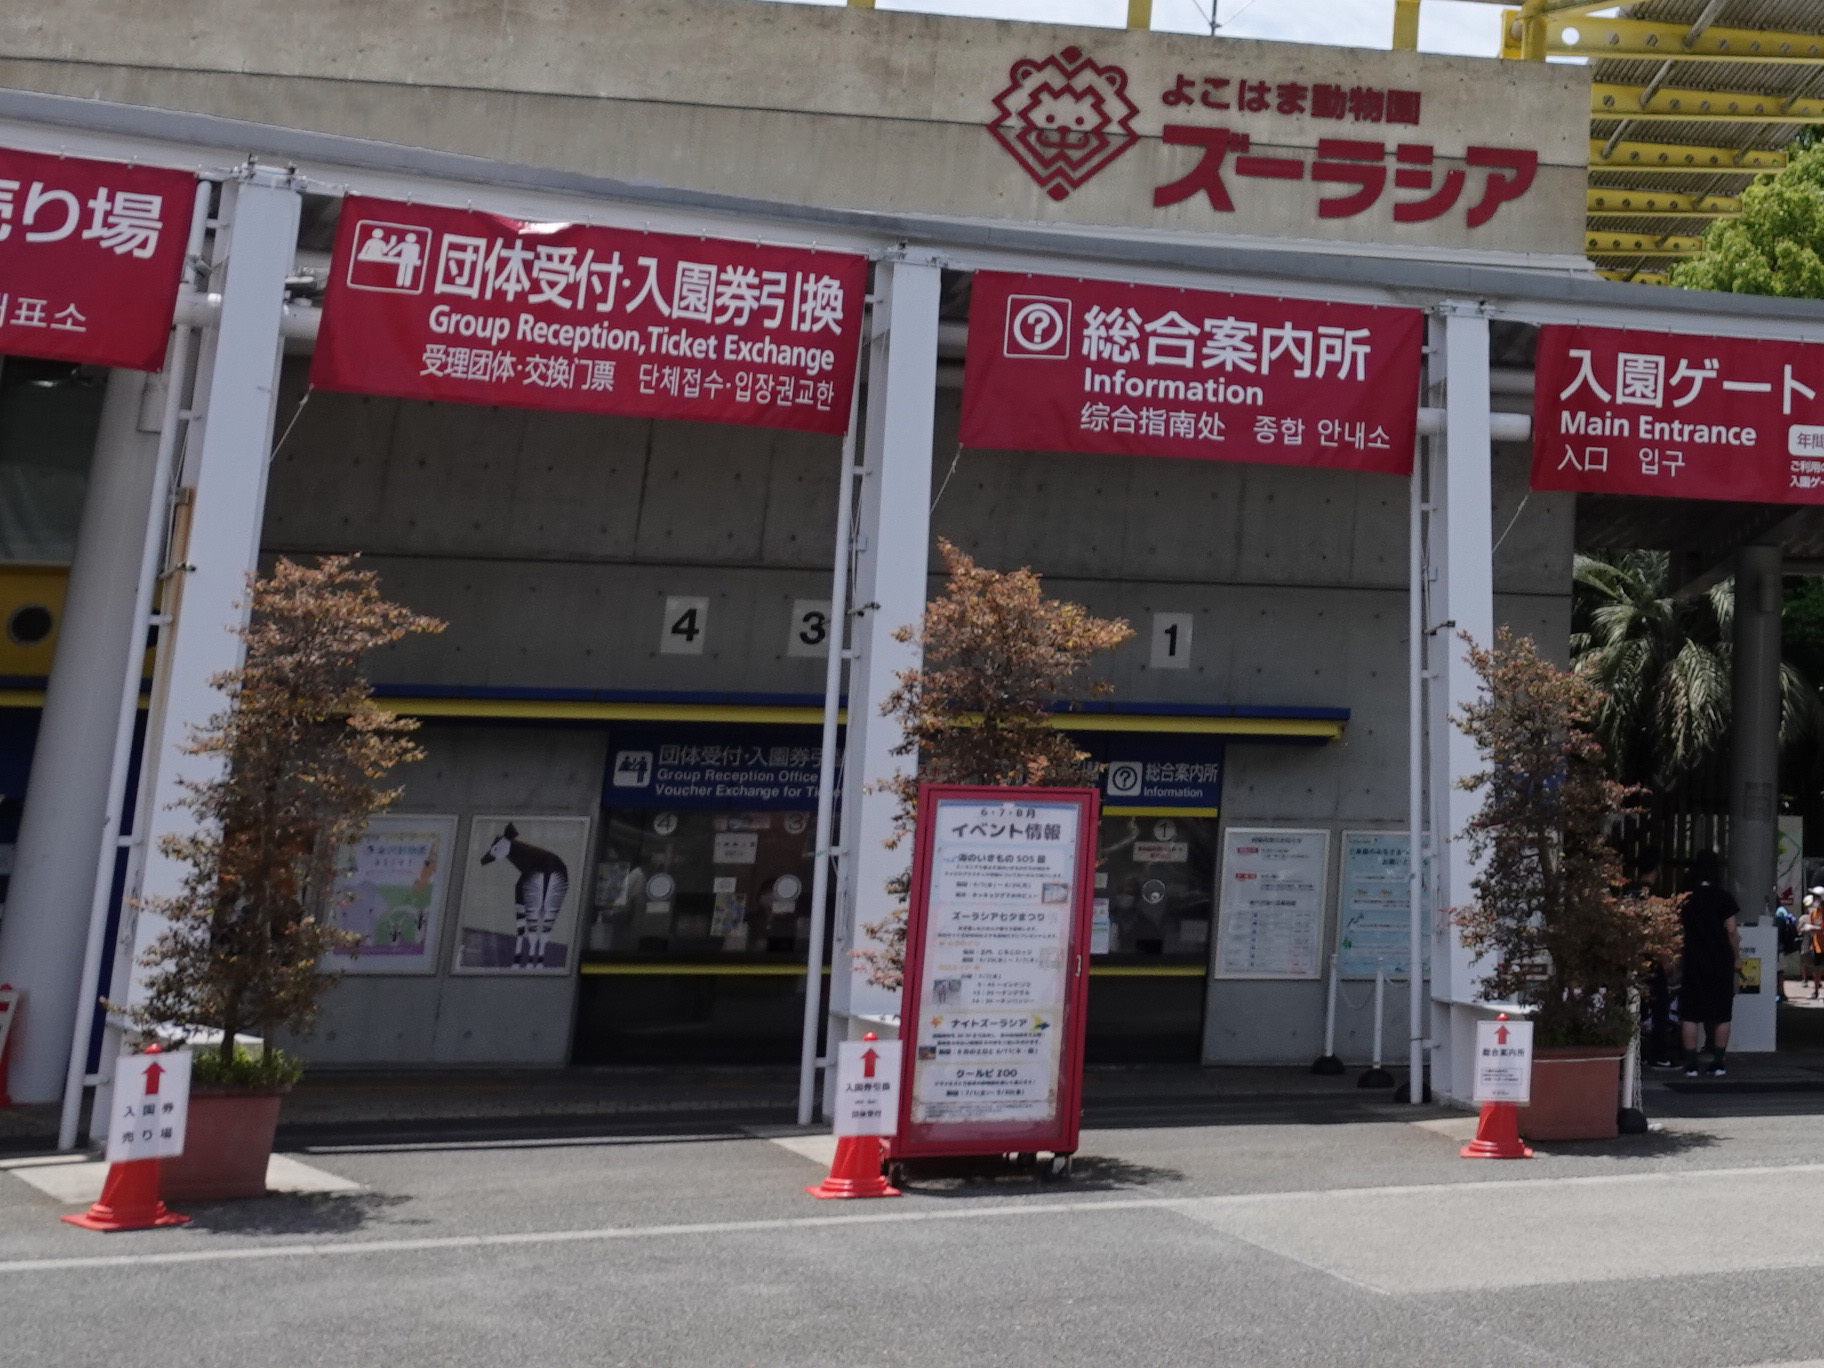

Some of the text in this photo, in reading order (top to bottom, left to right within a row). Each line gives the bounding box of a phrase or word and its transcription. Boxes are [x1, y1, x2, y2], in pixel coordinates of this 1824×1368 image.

[1161, 73, 1422, 125] よこはま動物園
[1153, 124, 1538, 228] ズーラシア
[433, 232, 845, 335] 団体受付・入園券引換
[428, 304, 511, 347] Group
[724, 333, 835, 376] Exchange
[1081, 304, 1372, 382] 総合案内所
[1083, 366, 1265, 407] Information
[1559, 348, 1816, 415] 入園ゲート
[1079, 401, 1226, 441] 综合指南处
[1252, 414, 1391, 451] 종합 안내소
[1559, 409, 1758, 447] Main Entrance
[1557, 443, 1609, 473] 入口
[1638, 446, 1687, 477] 입구
[671, 608, 700, 642] 4
[800, 610, 826, 645] 3
[1164, 623, 1178, 656] 1
[658, 744, 844, 767] 団体受付・入園券引
[1145, 762, 1219, 783] 総合案内所
[655, 783, 712, 796] Voucher
[715, 784, 779, 800] Exchange
[783, 785, 802, 797] for
[656, 768, 819, 783] Group Reception Office
[1143, 786, 1204, 798] Information
[952, 823, 1062, 840] イベント情報
[951, 1018, 1028, 1029] ナイトズーラシア
